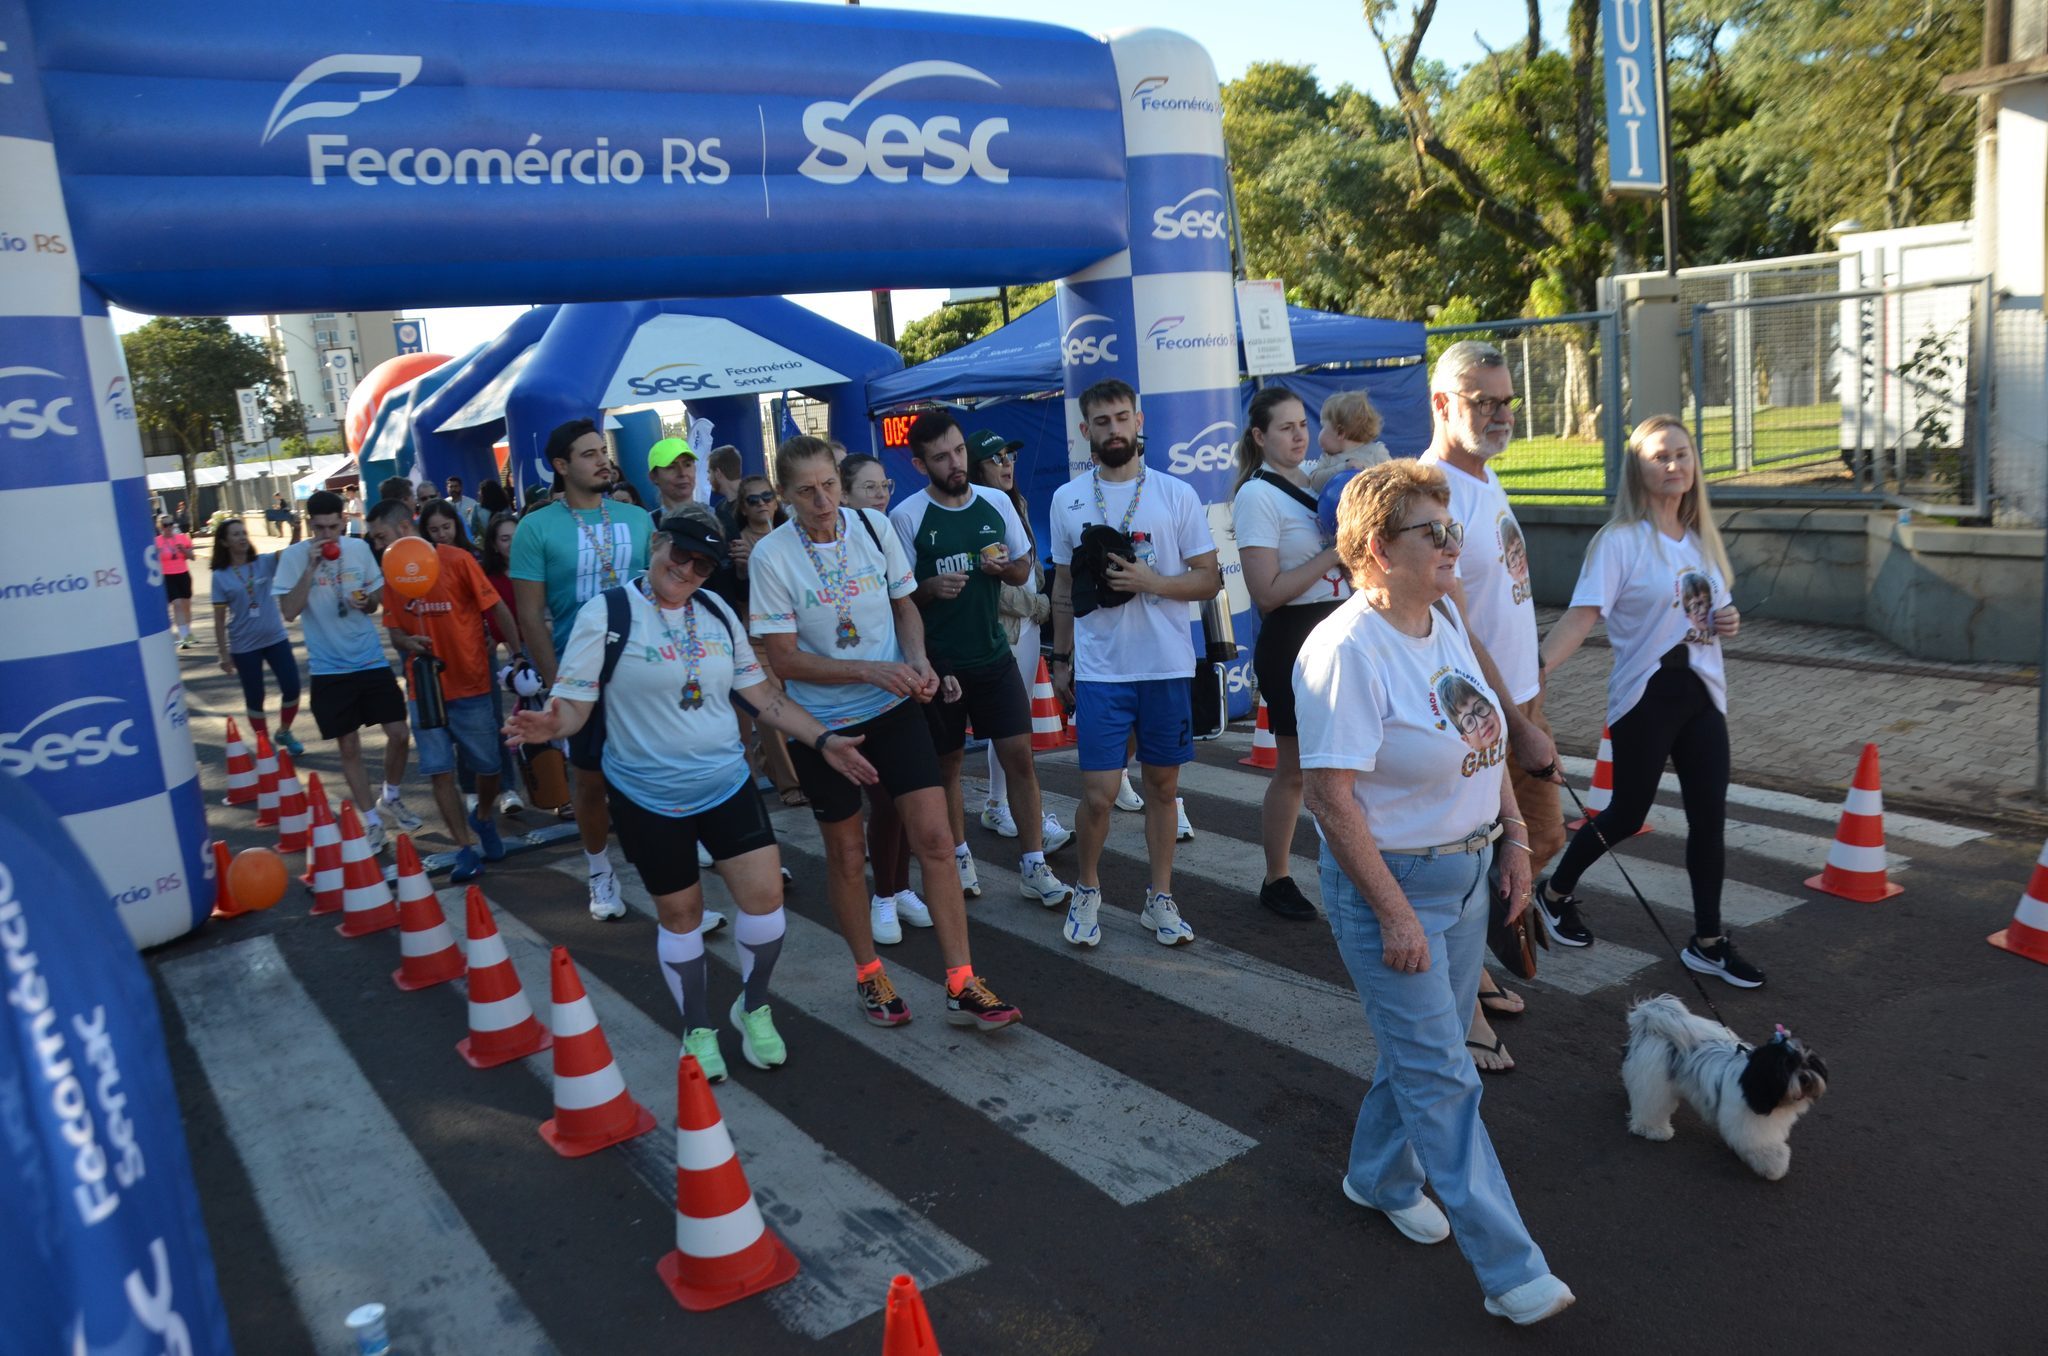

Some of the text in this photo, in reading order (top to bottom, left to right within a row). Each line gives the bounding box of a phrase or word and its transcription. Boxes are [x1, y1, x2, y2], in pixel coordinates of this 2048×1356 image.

[1615, 0, 1647, 178] URI
[798, 99, 1010, 185] Sesc
[307, 132, 731, 186] Fecomércio RS
[33, 233, 67, 254] RS
[1156, 333, 1229, 350] Fecomércio
[724, 359, 803, 377] Fecomércio
[335, 372, 350, 401] UR
[627, 372, 721, 397] Sesc
[0, 567, 122, 600] mércio RS
[1461, 738, 1505, 778] GAEL
[156, 873, 182, 895] RS
